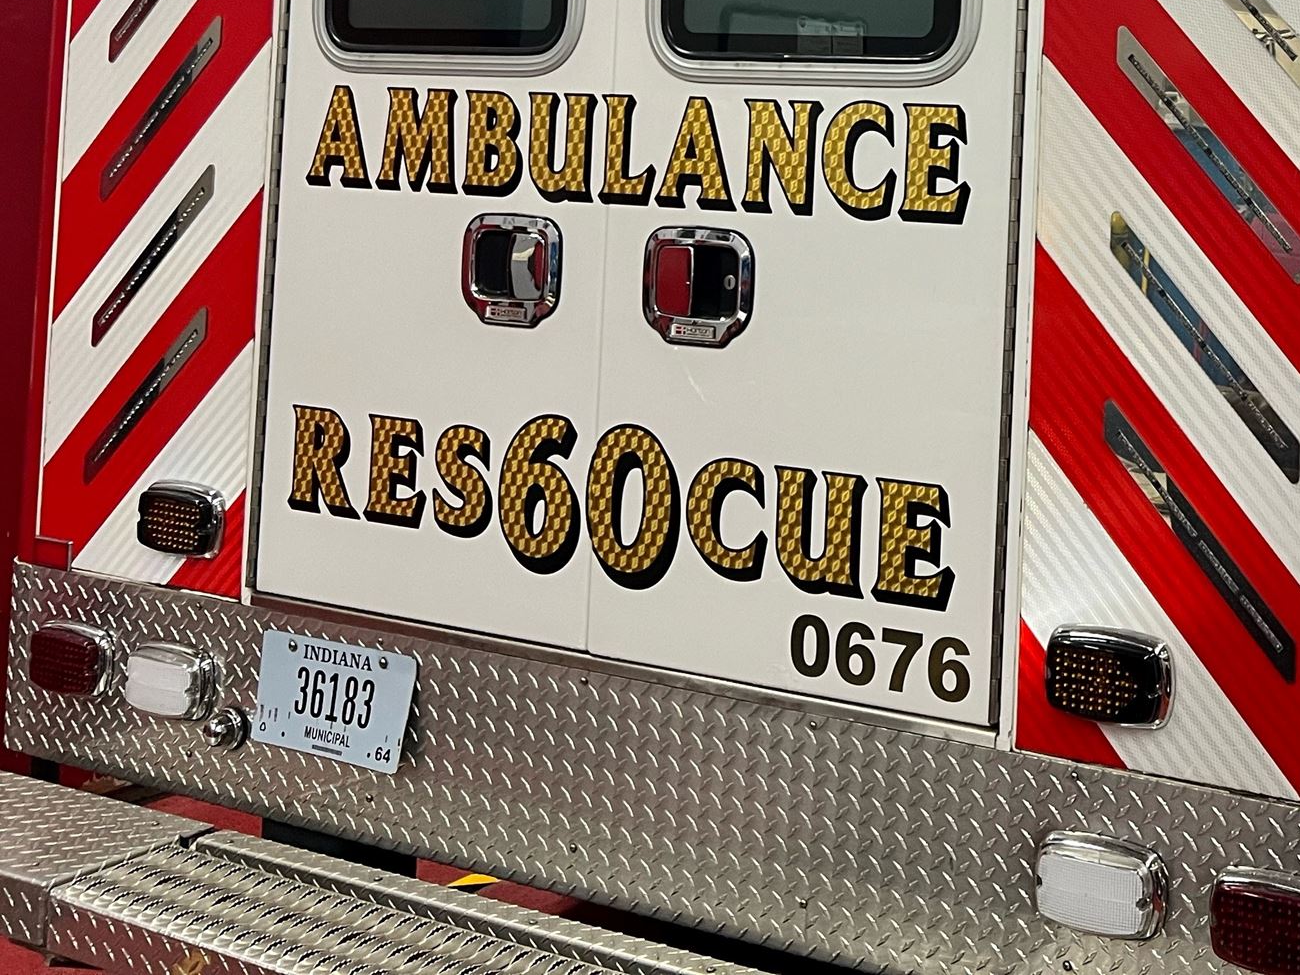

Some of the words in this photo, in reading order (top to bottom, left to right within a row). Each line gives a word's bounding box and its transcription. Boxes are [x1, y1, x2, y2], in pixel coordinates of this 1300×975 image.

[305, 84, 972, 225] AMBULANCE
[287, 404, 956, 613] RES60CUE
[303, 643, 373, 672] INDIANA
[790, 614, 972, 703] 0676
[294, 666, 376, 730] 36183
[303, 725, 351, 748] MUNICIPAL
[374, 746, 391, 764] 64
